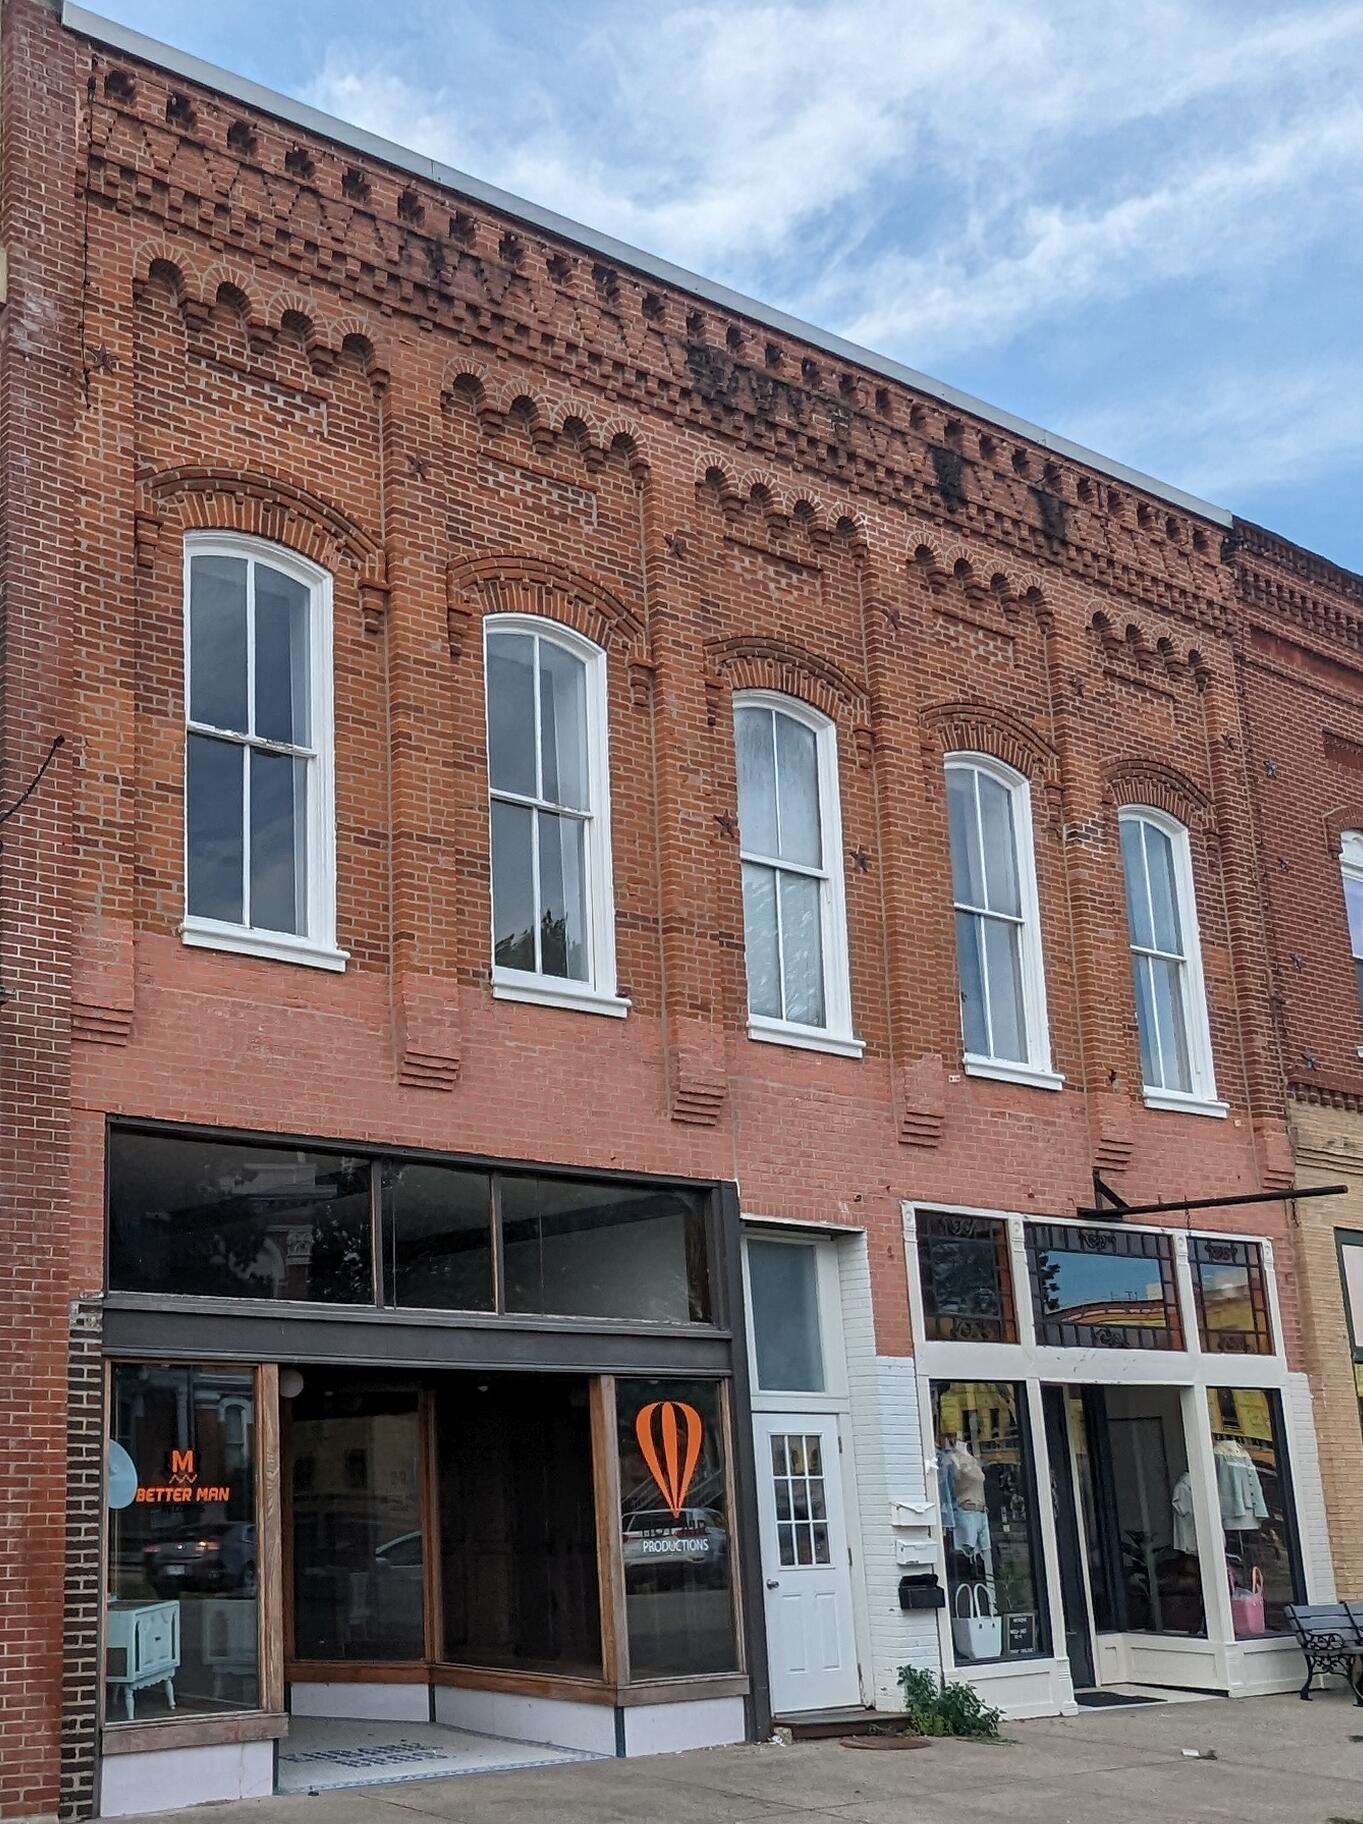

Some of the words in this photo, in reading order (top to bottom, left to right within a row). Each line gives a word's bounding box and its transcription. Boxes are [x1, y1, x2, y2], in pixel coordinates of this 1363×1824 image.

[172, 1449, 194, 1473] M
[136, 1488, 192, 1502] BETTER
[196, 1487, 230, 1502] MAN
[642, 1538, 709, 1552] PRODUCTIONS
